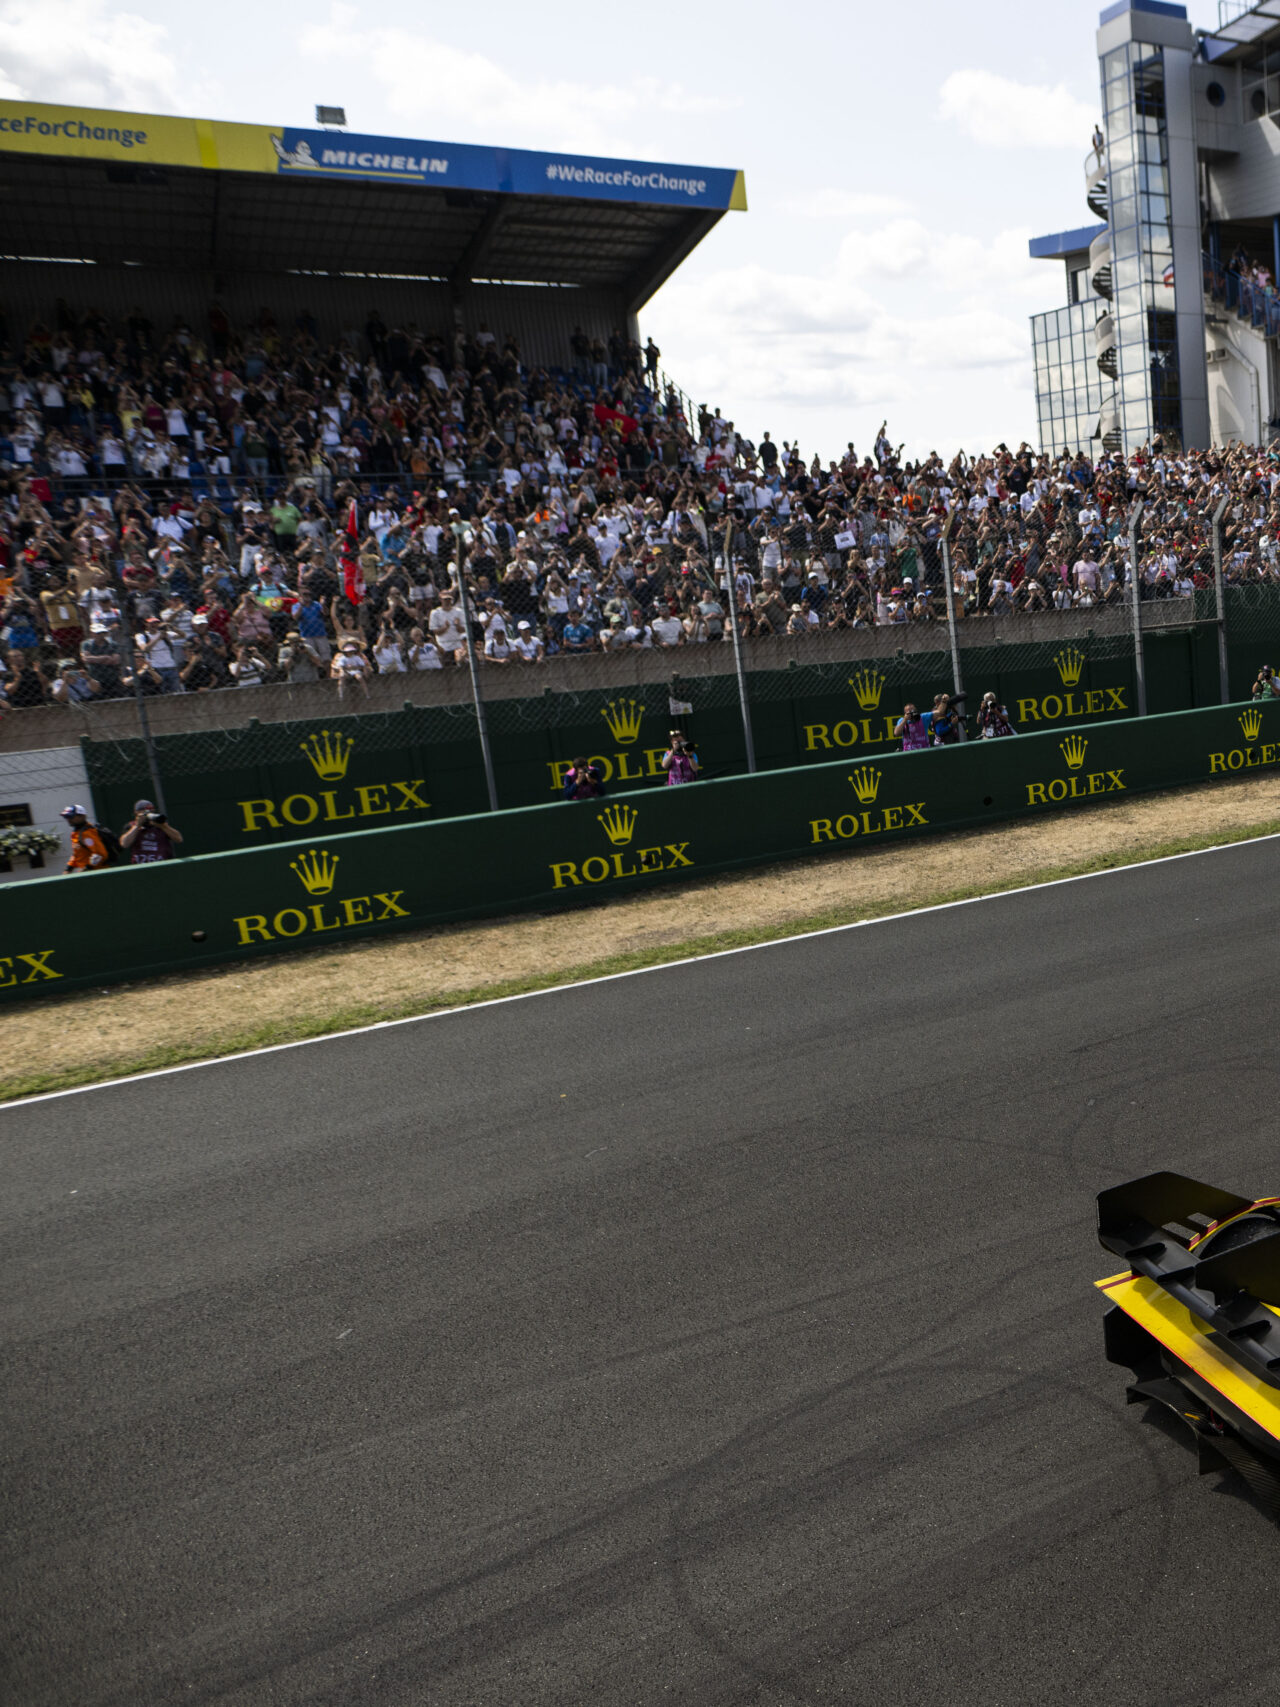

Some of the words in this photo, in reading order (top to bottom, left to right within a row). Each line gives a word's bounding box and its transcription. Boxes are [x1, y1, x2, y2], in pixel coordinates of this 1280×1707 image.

[0, 116, 148, 148] ceForChange
[322, 149, 449, 174] MICHELIN
[545, 163, 707, 196] #WeRaceForChange
[1016, 686, 1128, 723] ROLEX
[546, 744, 703, 790] ROLE
[1025, 768, 1126, 806] ROLEX
[238, 779, 430, 832] ROLEX
[809, 801, 929, 844] ROLEX
[549, 842, 695, 889] ROLEX
[233, 890, 411, 945] ROLEX
